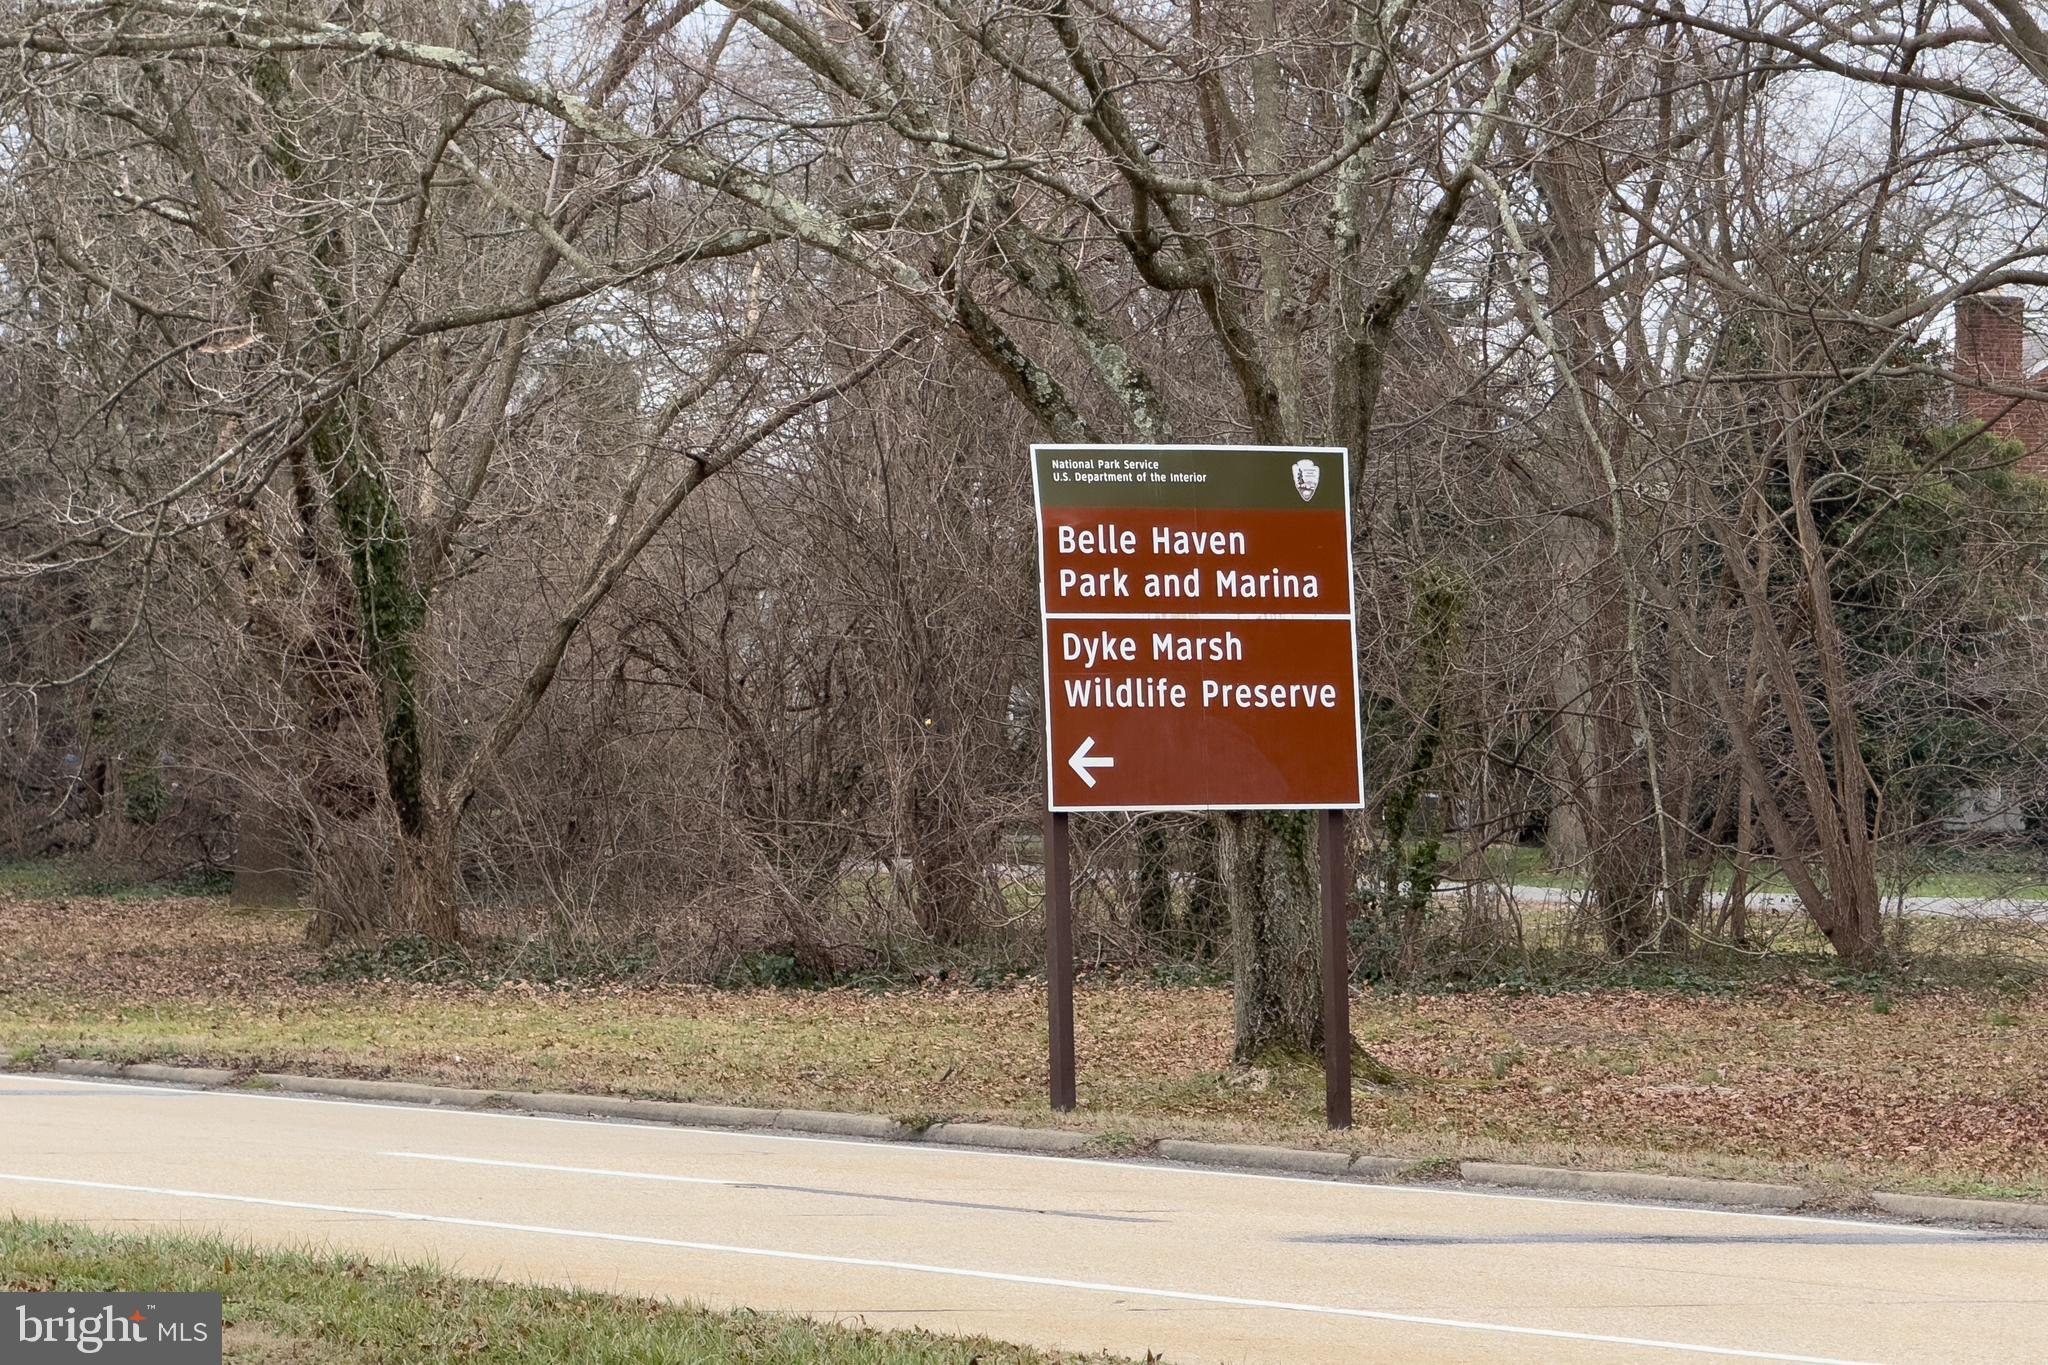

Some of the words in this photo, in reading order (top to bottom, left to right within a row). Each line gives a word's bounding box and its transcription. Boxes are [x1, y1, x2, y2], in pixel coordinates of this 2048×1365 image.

[1052, 459, 1095, 470] National
[1098, 460, 1121, 470] Park
[1124, 460, 1160, 470] Service
[1053, 472, 1072, 482] U.S.
[1075, 472, 1133, 484] Department
[1137, 472, 1147, 482] of
[1150, 472, 1167, 483] the
[1171, 472, 1207, 483] Interior
[1059, 525, 1136, 554] Belle
[1153, 527, 1245, 554] Haven
[1060, 568, 1129, 596] Park
[1145, 569, 1199, 597] and
[1217, 568, 1318, 597] Marina
[1063, 631, 1136, 668] Dyke
[1153, 632, 1241, 660] Marsh
[1065, 677, 1186, 707] Wildlife
[1203, 680, 1335, 707] Preserve
